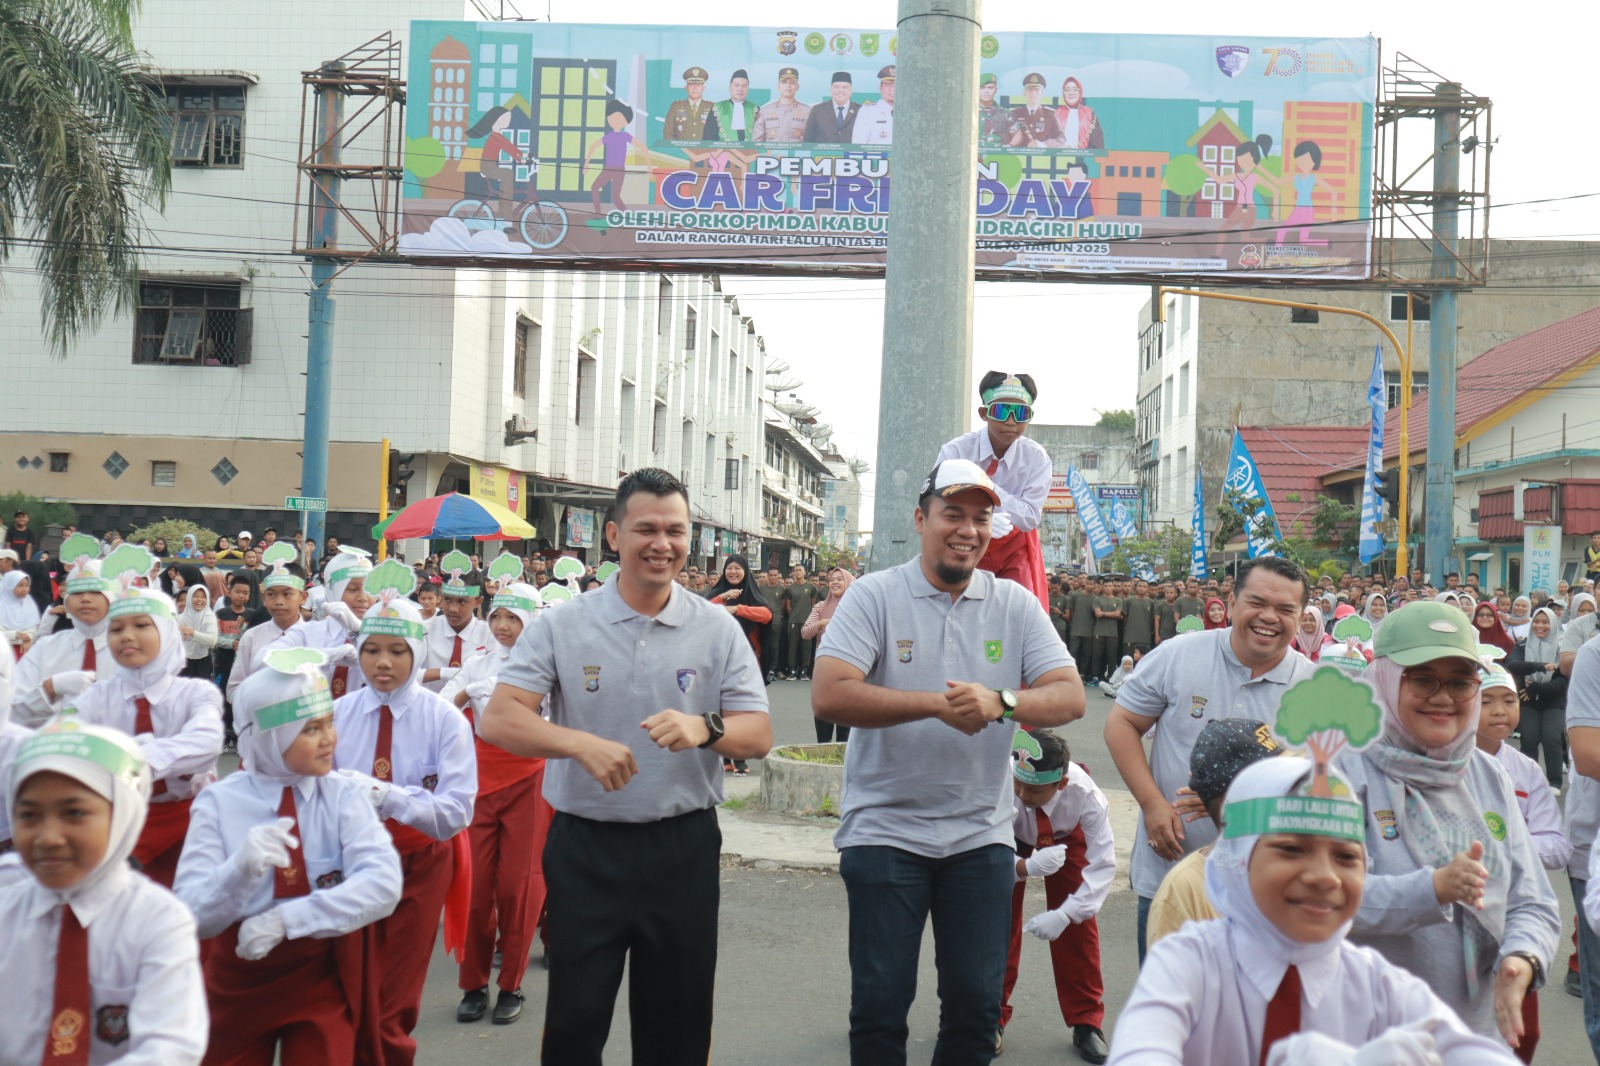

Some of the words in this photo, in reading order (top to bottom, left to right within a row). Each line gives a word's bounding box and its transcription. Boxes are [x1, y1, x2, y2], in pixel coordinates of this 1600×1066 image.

[660, 170, 785, 212] CAR
[977, 178, 1091, 219] DAY
[606, 210, 665, 228] OLEH
[668, 211, 818, 232] FORKOPIMDA
[1077, 222, 1142, 240] HULU
[636, 231, 687, 243] DALAM
[688, 232, 748, 245] RANGKA
[750, 234, 784, 246] HARI
[786, 235, 822, 247] LALU
[823, 236, 872, 248] LINTAS
[1024, 241, 1073, 253] TAHUN
[1076, 243, 1110, 254] 2025
[295, 499, 304, 510] YOS
[304, 499, 326, 511] SUDARSO
[1541, 563, 1550, 587] PLN
[1276, 798, 1302, 813] HARI
[1304, 800, 1330, 815] LALU
[1331, 802, 1359, 819] LINTAS
[1268, 815, 1341, 833] BHAYANGKARA
